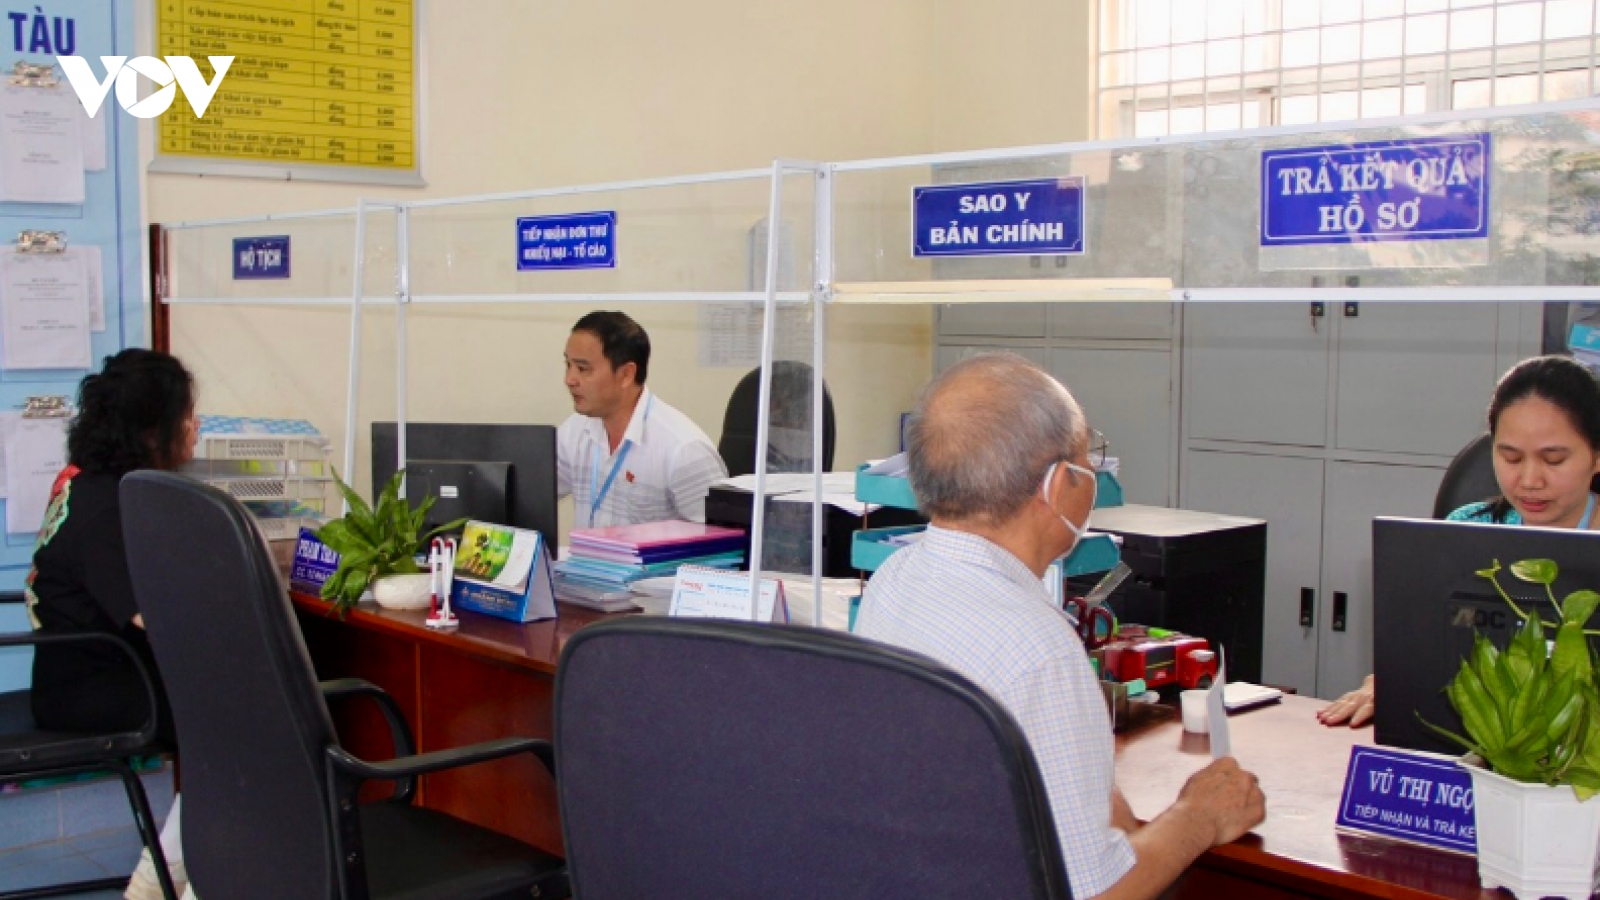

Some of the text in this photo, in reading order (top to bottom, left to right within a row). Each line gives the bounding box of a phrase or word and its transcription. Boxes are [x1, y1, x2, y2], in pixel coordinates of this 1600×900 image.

[8, 5, 75, 56] TÀU
[1278, 147, 1467, 196] TRẢ KẾT QUẢ
[960, 192, 1031, 213] SAO Y
[1318, 192, 1421, 232] HỒ SƠ
[523, 224, 541, 241] TIẾP
[543, 225, 568, 242] NHẬN
[930, 219, 1064, 245] BẢN CHÍNH
[240, 245, 282, 270] HỘ TỊCH
[587, 242, 607, 257] CÁO
[1369, 767, 1394, 794] VŨ
[1398, 776, 1433, 806] THỊ
[1355, 803, 1379, 818] TIẾP
[1380, 809, 1413, 827] NHẬN
